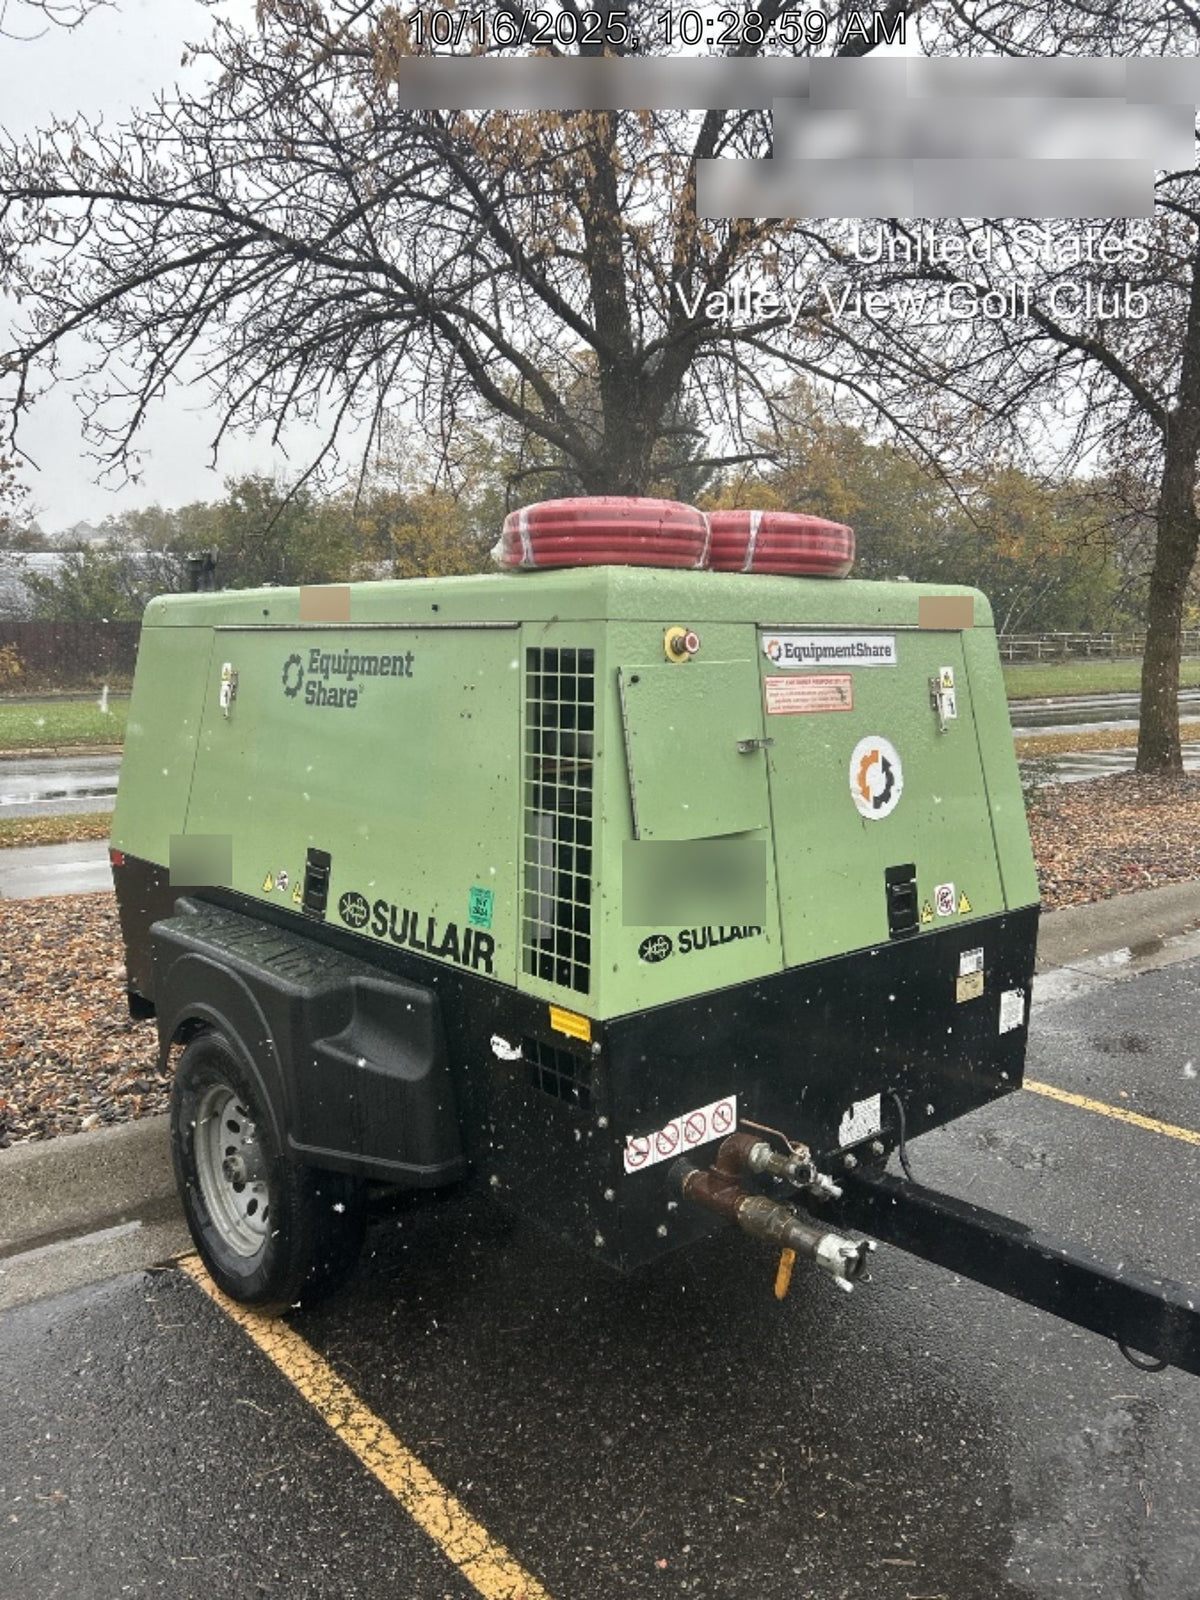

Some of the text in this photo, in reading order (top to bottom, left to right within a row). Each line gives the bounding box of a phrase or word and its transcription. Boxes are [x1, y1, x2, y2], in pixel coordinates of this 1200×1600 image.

[307, 649, 415, 681] Equipment
[783, 641, 892, 662] EquipmentShare
[371, 899, 496, 975] SULLAIR
